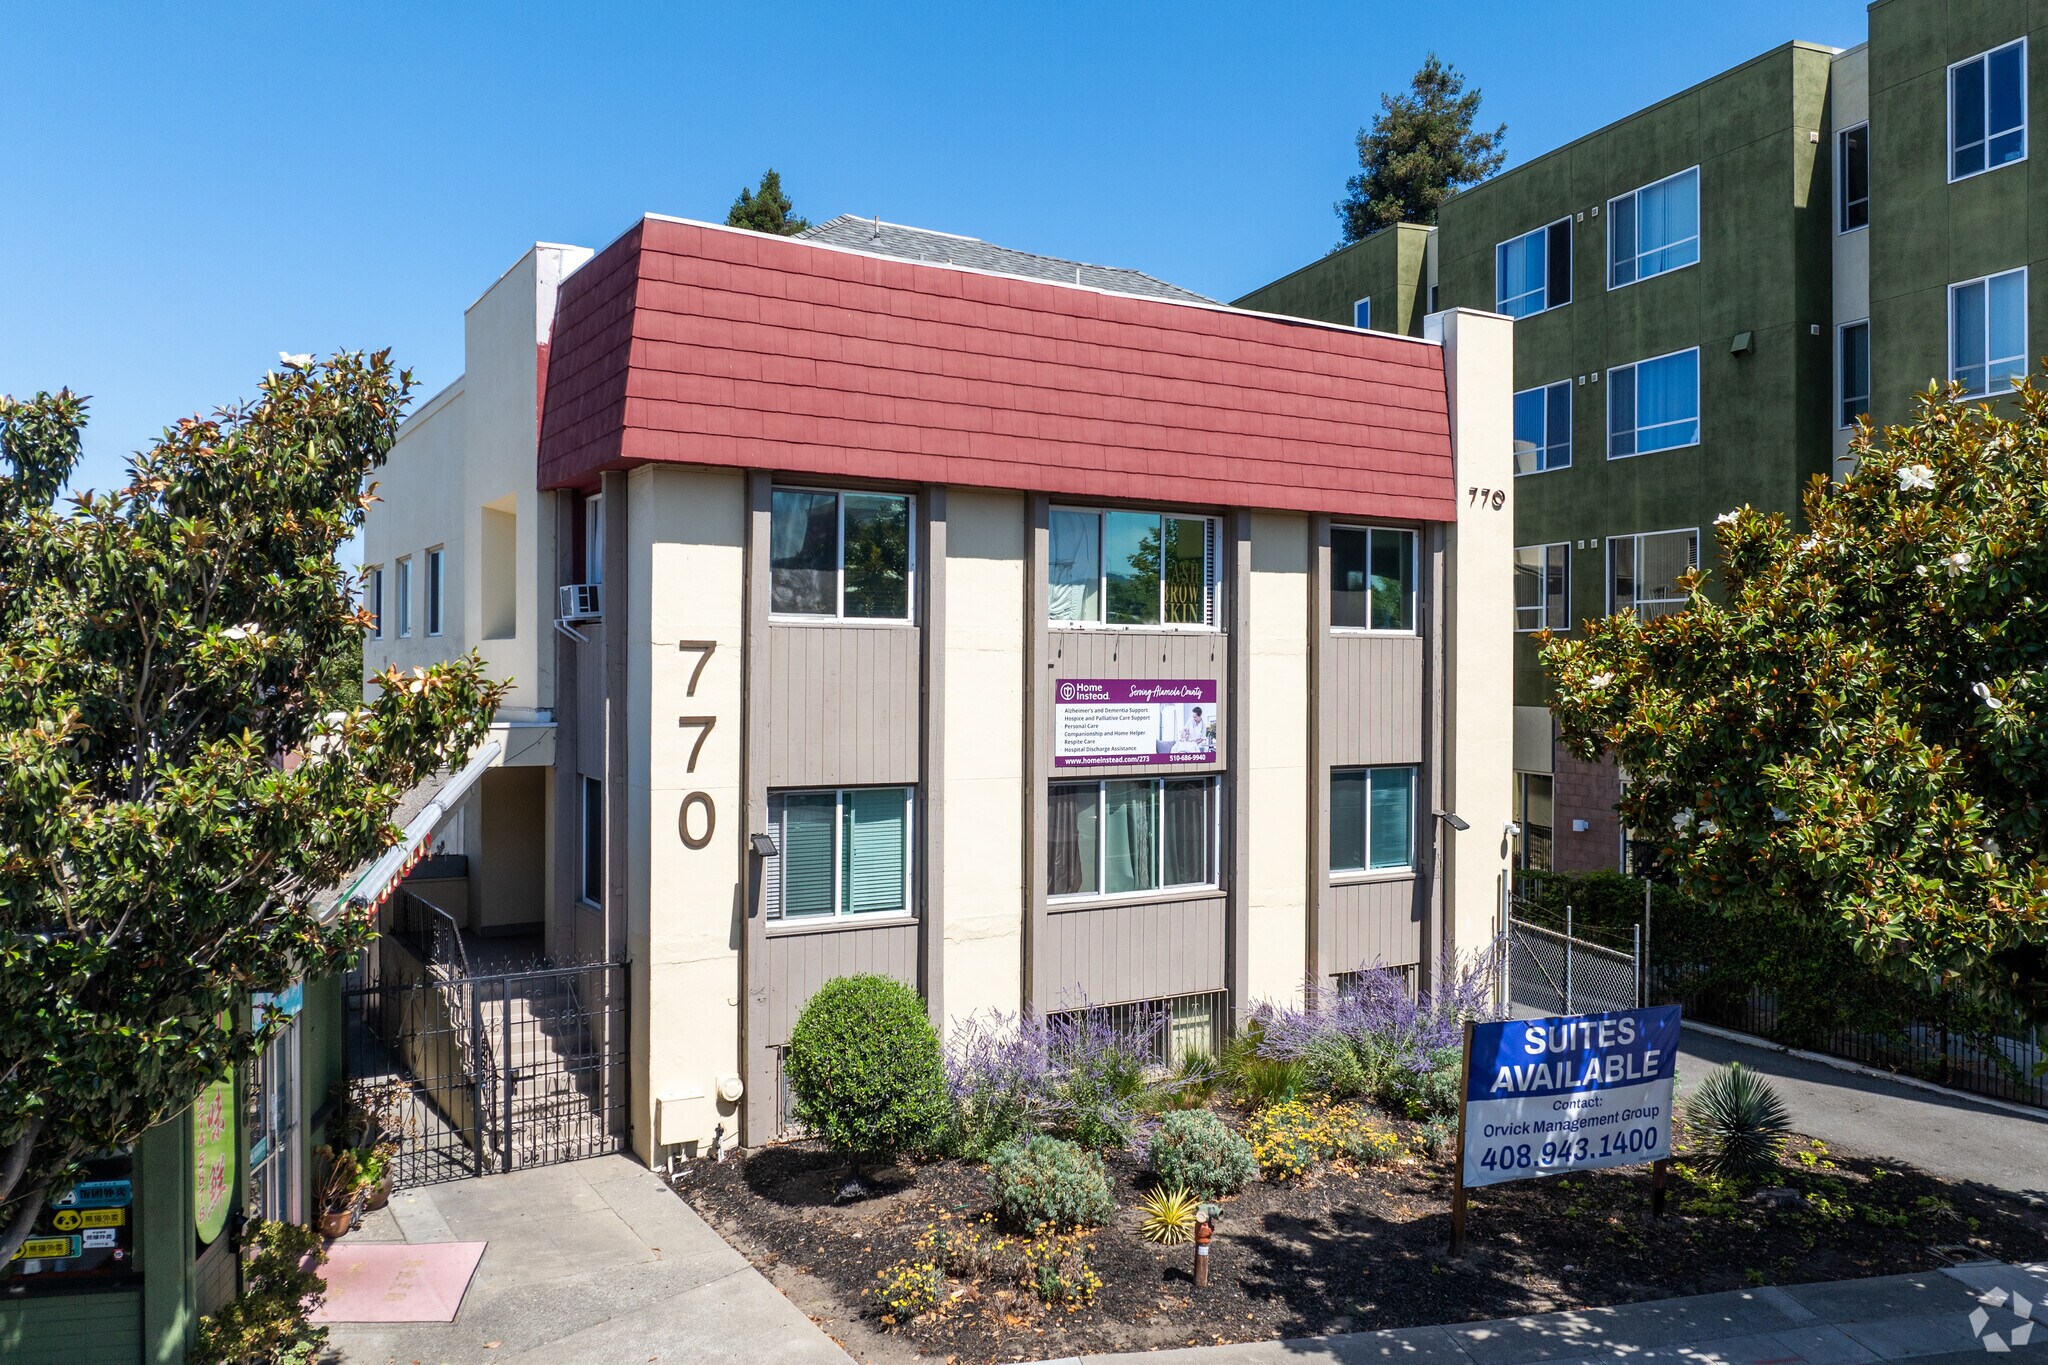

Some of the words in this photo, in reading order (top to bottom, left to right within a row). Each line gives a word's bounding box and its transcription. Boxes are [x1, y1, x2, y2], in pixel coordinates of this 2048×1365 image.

[1468, 487, 1506, 510] 770
[1166, 561, 1199, 583] ASH
[1076, 683, 1103, 692] Home
[1128, 684, 1152, 702] Serving
[1152, 685, 1180, 698] Alameda
[1180, 685, 1204, 700] County
[678, 640, 717, 850] 770
[1524, 1017, 1636, 1055] SUITES
[1489, 1050, 1661, 1093] AVAILABLE
[1552, 1096, 1603, 1111] Contact:
[1483, 1122, 1530, 1138] Orvick
[1532, 1112, 1619, 1135] Management
[1621, 1105, 1660, 1122] Group
[1480, 1126, 1658, 1171] 408.943.1400
